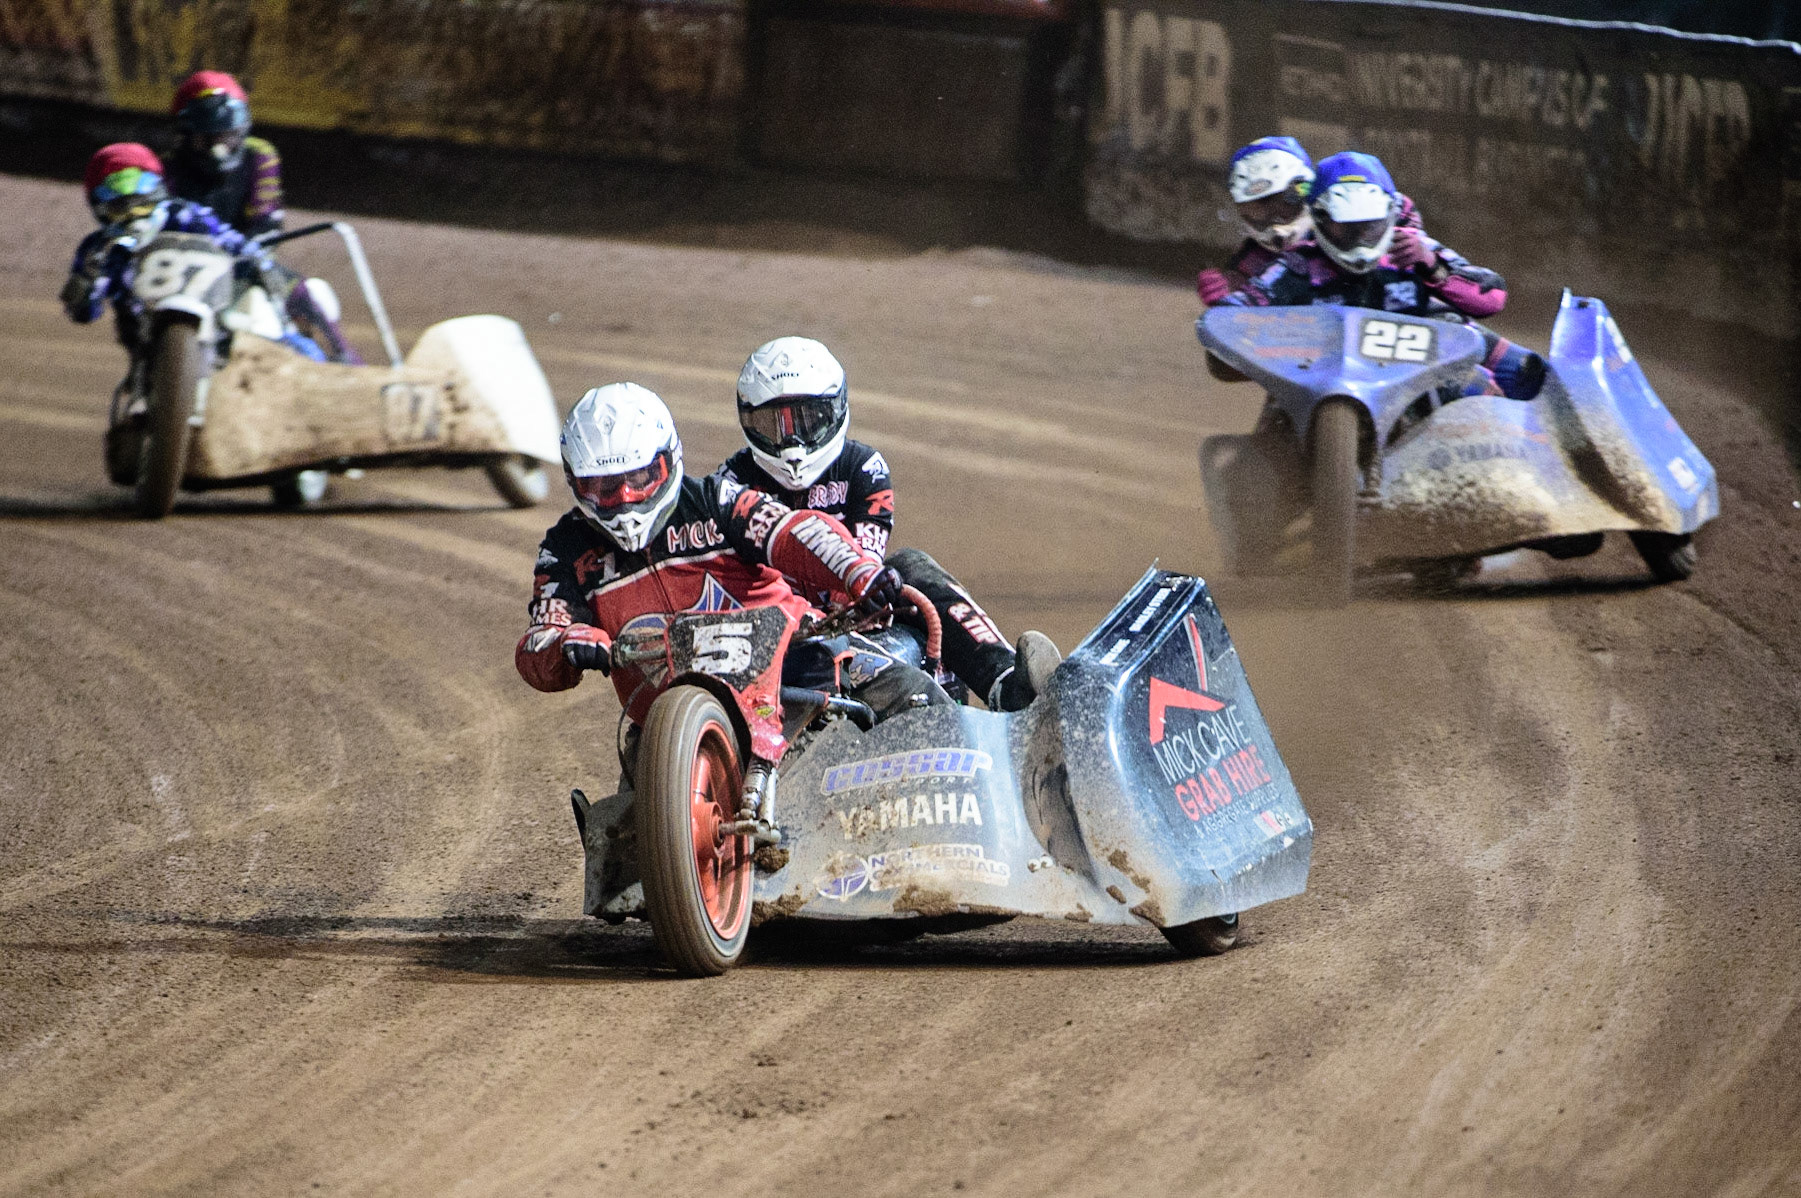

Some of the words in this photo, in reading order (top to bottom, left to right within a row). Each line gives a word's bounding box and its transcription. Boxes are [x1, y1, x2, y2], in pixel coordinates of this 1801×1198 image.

[133, 249, 231, 299] 87
[1361, 320, 1431, 361] 22
[807, 480, 849, 510] BRADY
[667, 518, 725, 554] MICK
[691, 622, 753, 675] 5
[961, 615, 999, 645] TIP
[1153, 729, 1207, 785] MICK
[1197, 705, 1252, 760] CAVE
[1175, 767, 1232, 821] GRAB
[1221, 744, 1271, 796] HIRE
[839, 793, 983, 840] YAMAHA
[871, 845, 981, 868] NORERN
